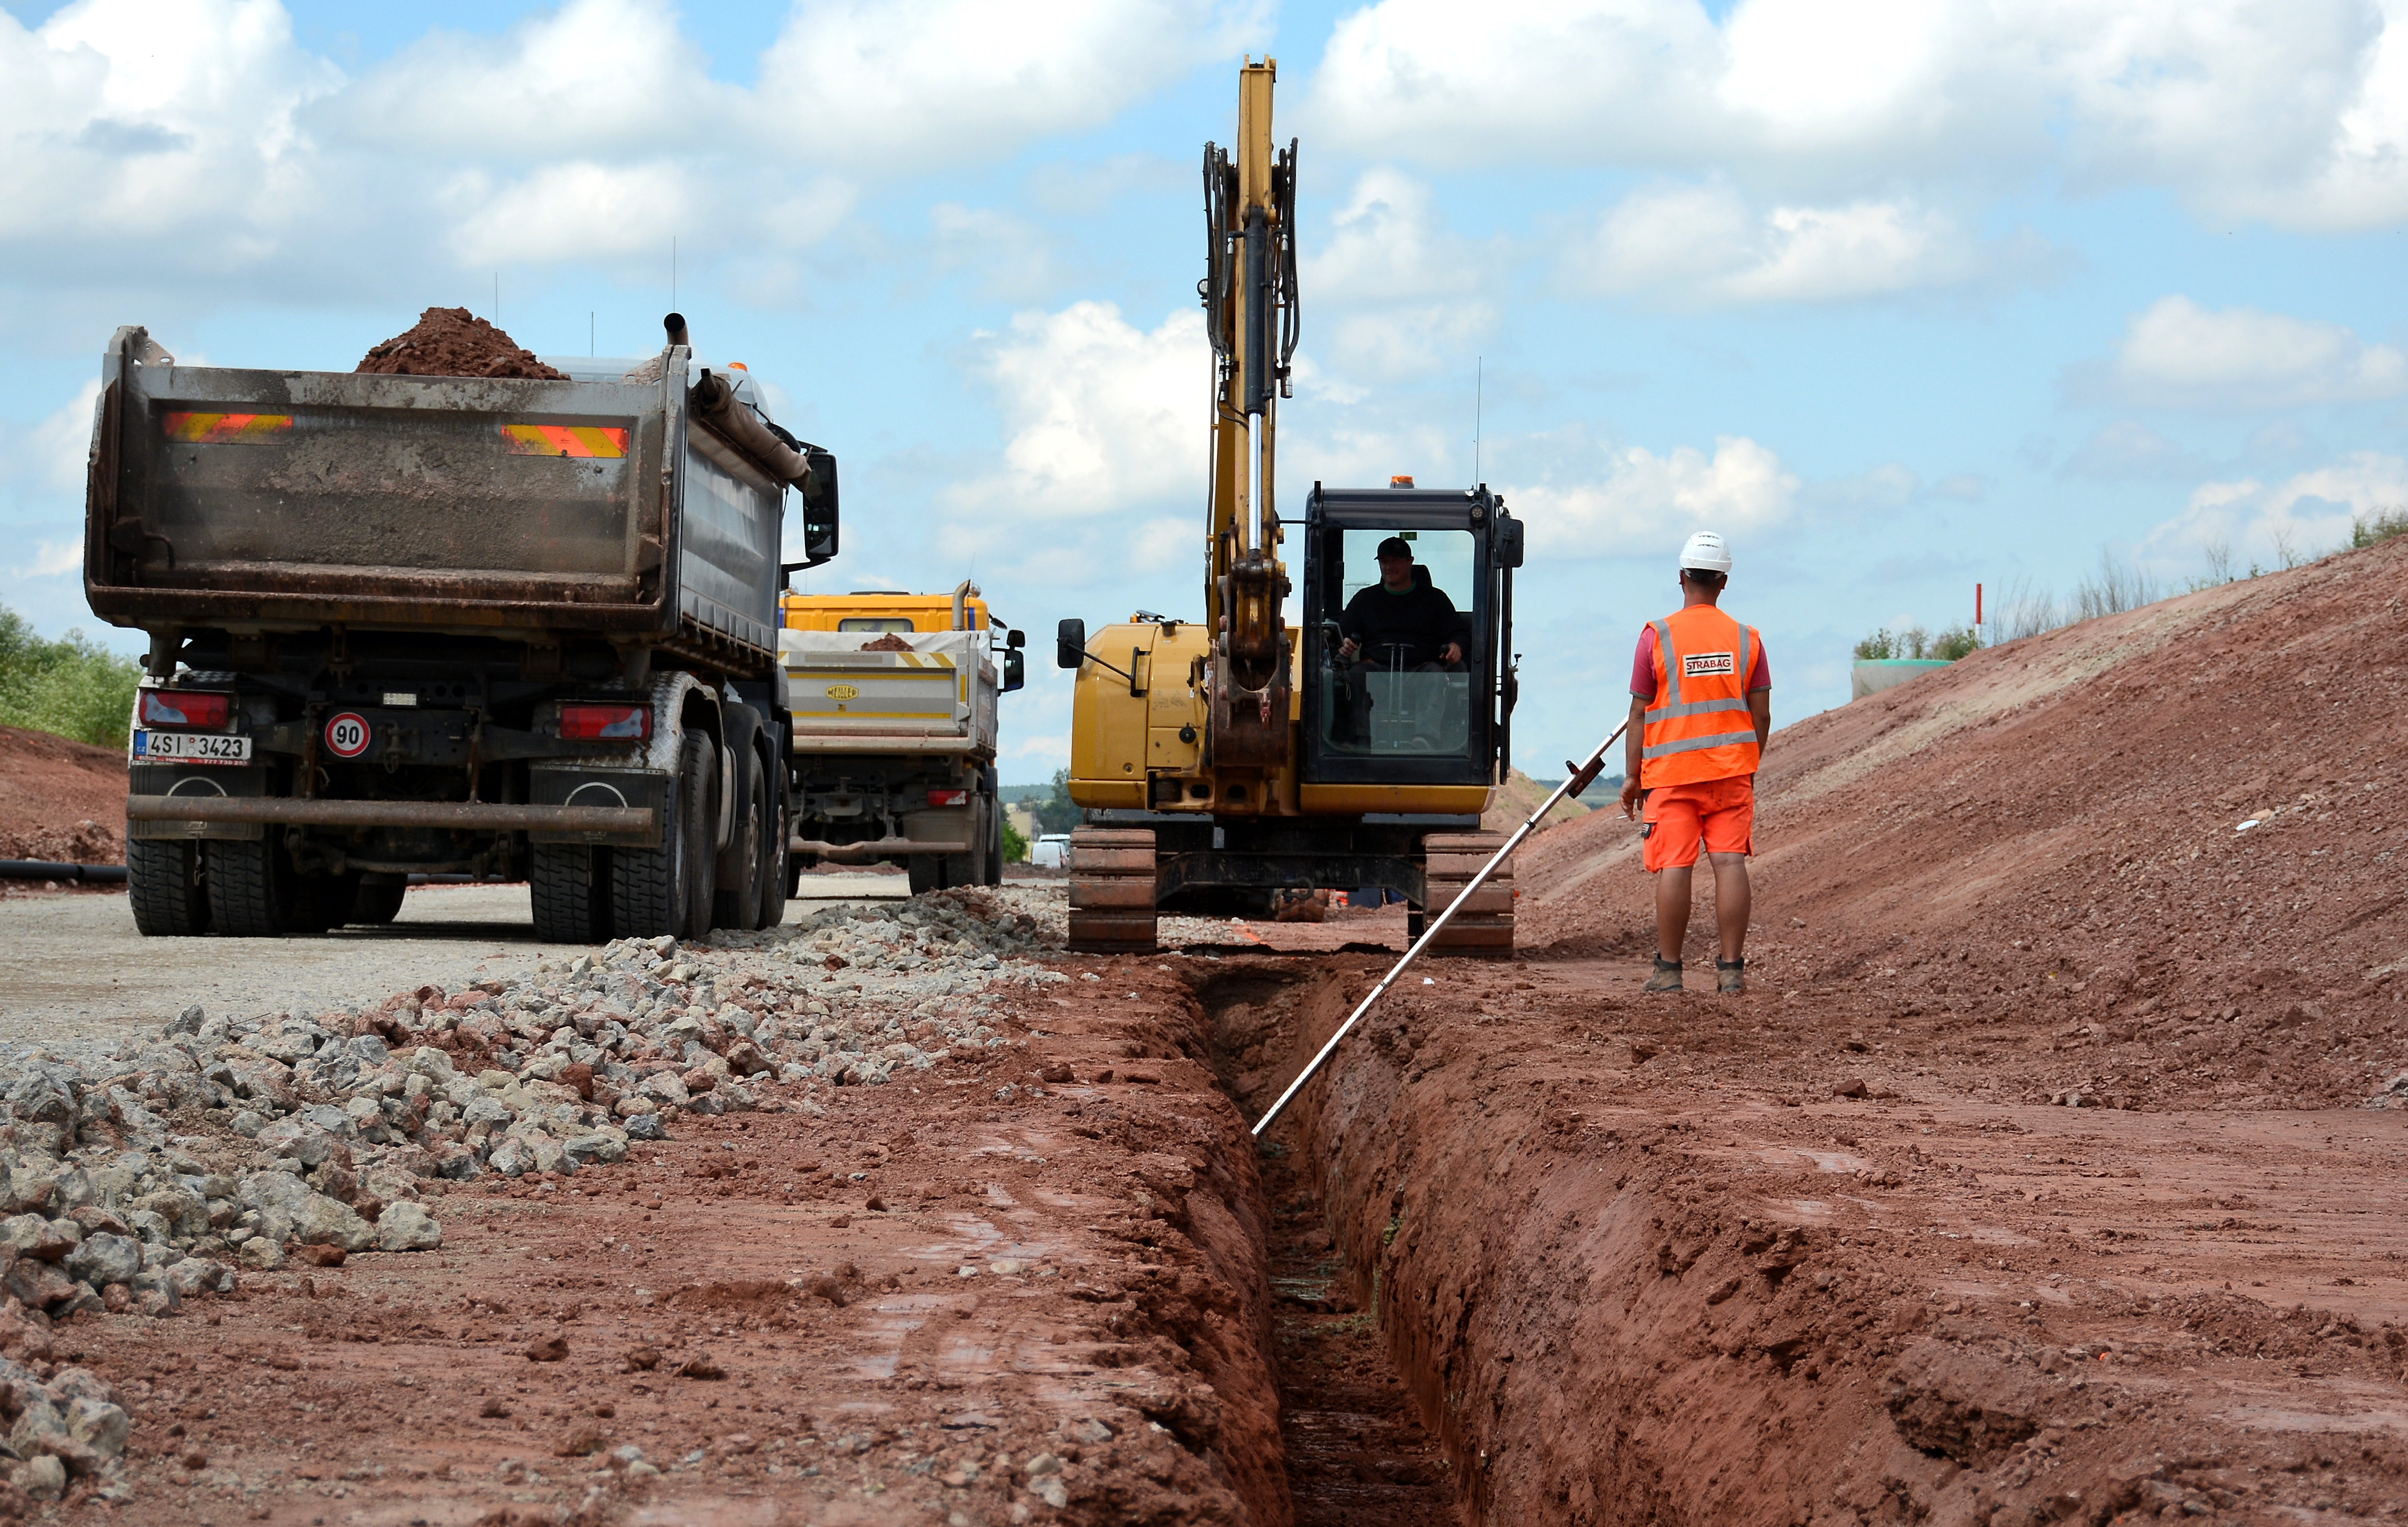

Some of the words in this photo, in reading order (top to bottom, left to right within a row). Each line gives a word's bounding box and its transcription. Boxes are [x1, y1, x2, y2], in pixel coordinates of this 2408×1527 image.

[1687, 659, 1731, 670] STRABAG
[337, 725, 359, 744] 90
[151, 736, 180, 754] 4SI
[198, 738, 243, 757] 3423
